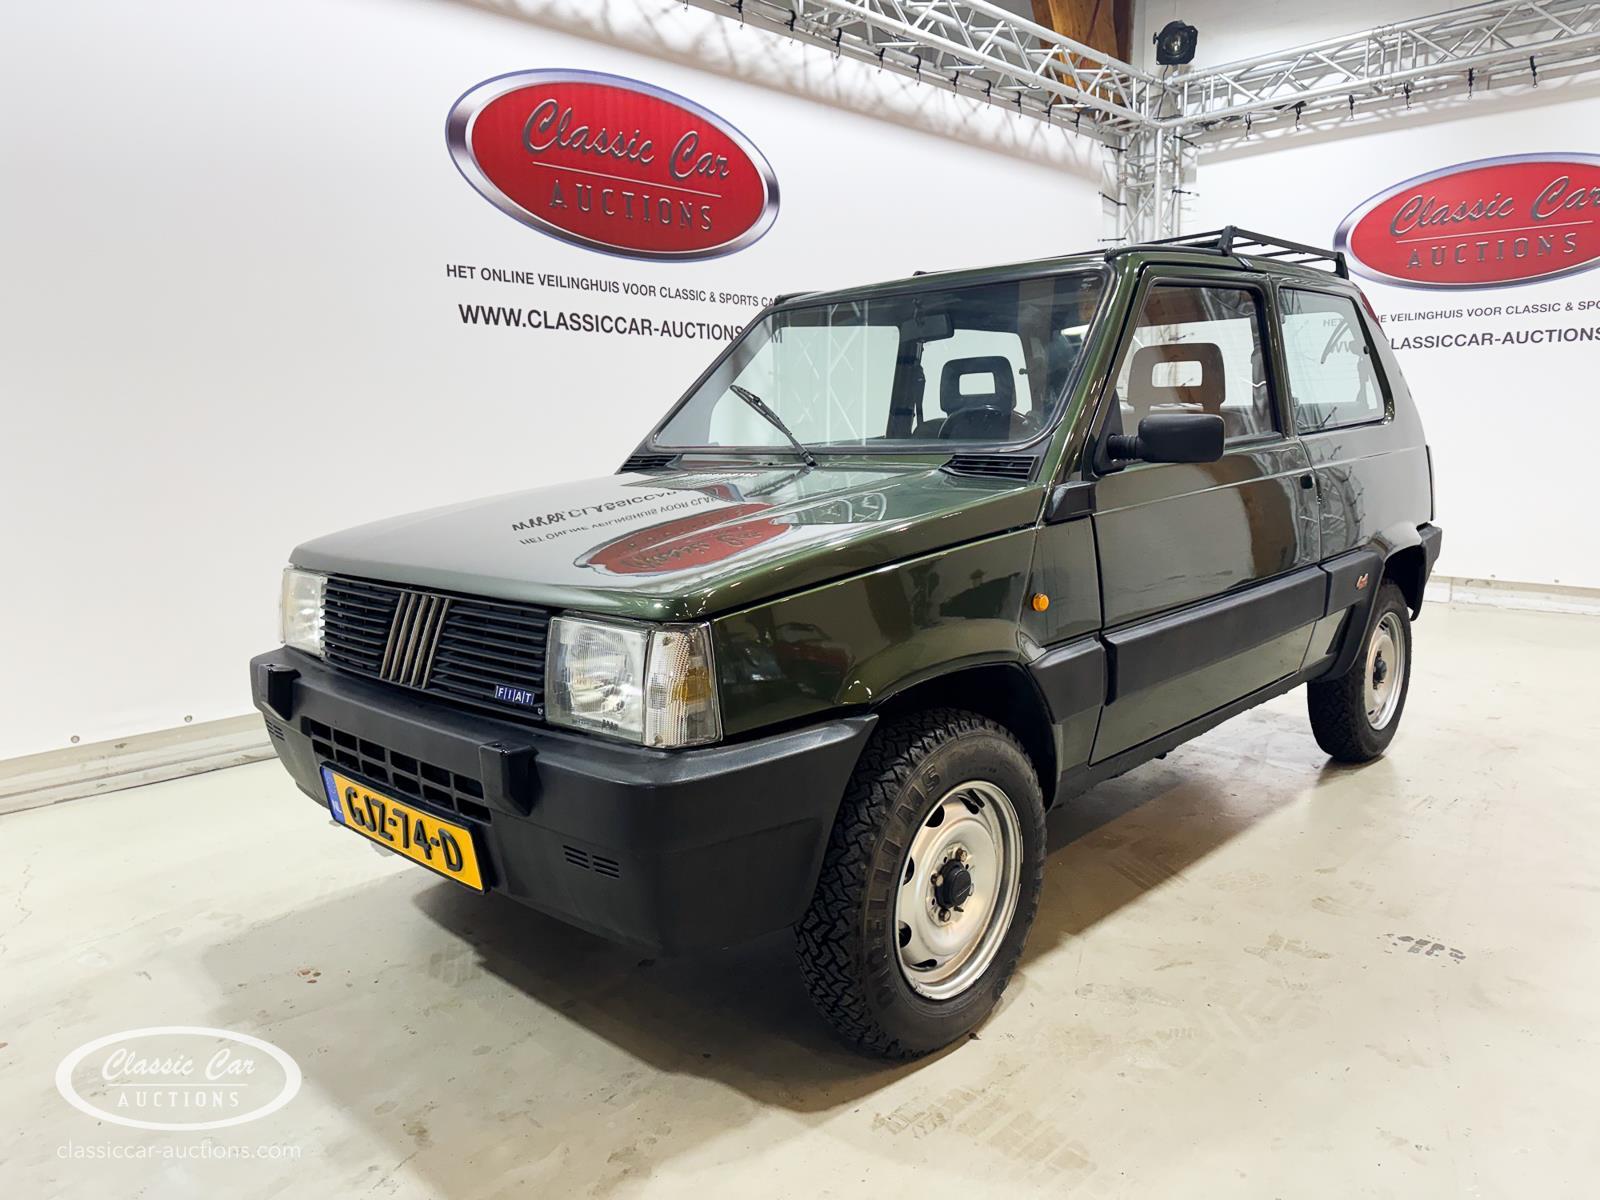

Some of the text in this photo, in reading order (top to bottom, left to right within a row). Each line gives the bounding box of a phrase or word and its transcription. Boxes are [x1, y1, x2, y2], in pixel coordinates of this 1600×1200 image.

[523, 98, 730, 179] Classic Car
[549, 179, 714, 231] AUCTIONS
[1389, 175, 1600, 236] Classic Car
[1406, 232, 1577, 269] AUCTIONS
[446, 263, 476, 279] HET
[480, 267, 535, 285] ONLINE
[537, 272, 620, 294] VEILINGHUIS
[622, 281, 657, 297] VOOR
[659, 286, 706, 302] CLASSIC
[709, 291, 716, 303] &
[719, 292, 759, 307] SPORTS
[1390, 309, 1463, 322] VEILINGHUIS
[1467, 306, 1501, 317] VOOR
[1505, 302, 1561, 316] CLASSIC
[1565, 301, 1573, 311] &
[497, 686, 533, 704] FIAT
[345, 786, 463, 872] GJZ-74-D
